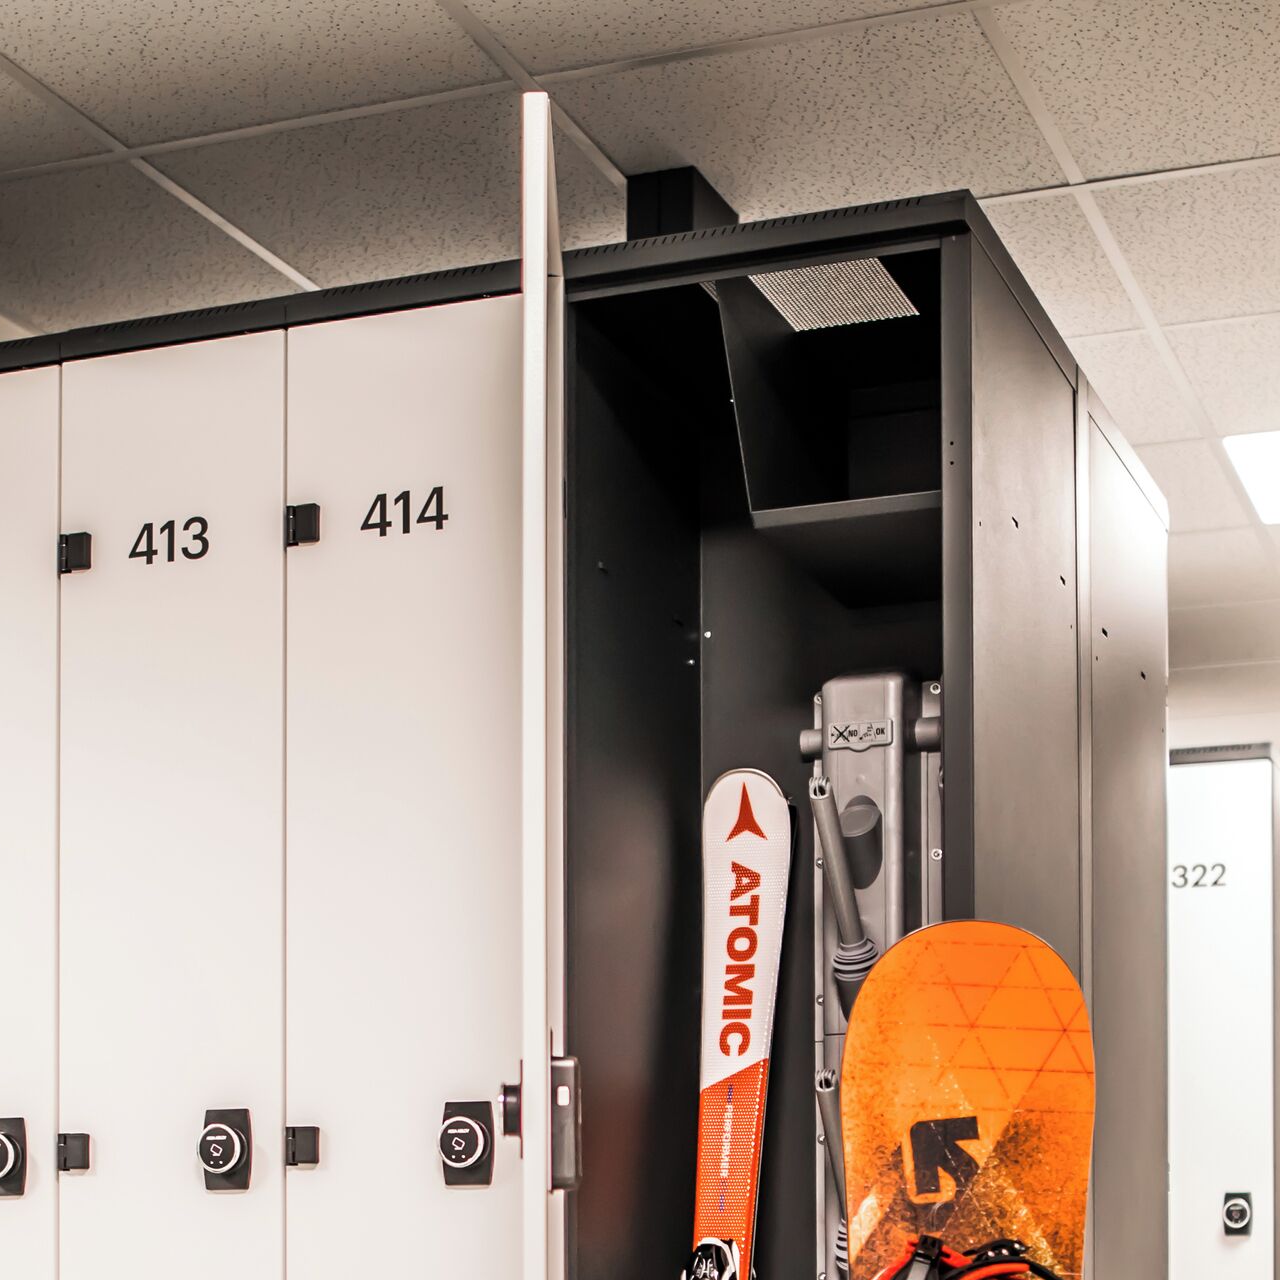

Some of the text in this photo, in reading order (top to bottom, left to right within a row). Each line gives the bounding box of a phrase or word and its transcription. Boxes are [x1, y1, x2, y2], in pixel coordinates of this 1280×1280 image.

[362, 486, 449, 539] 414
[129, 516, 210, 566] 413
[1171, 863, 1228, 890] 322
[719, 861, 761, 1057] ATOMIC
